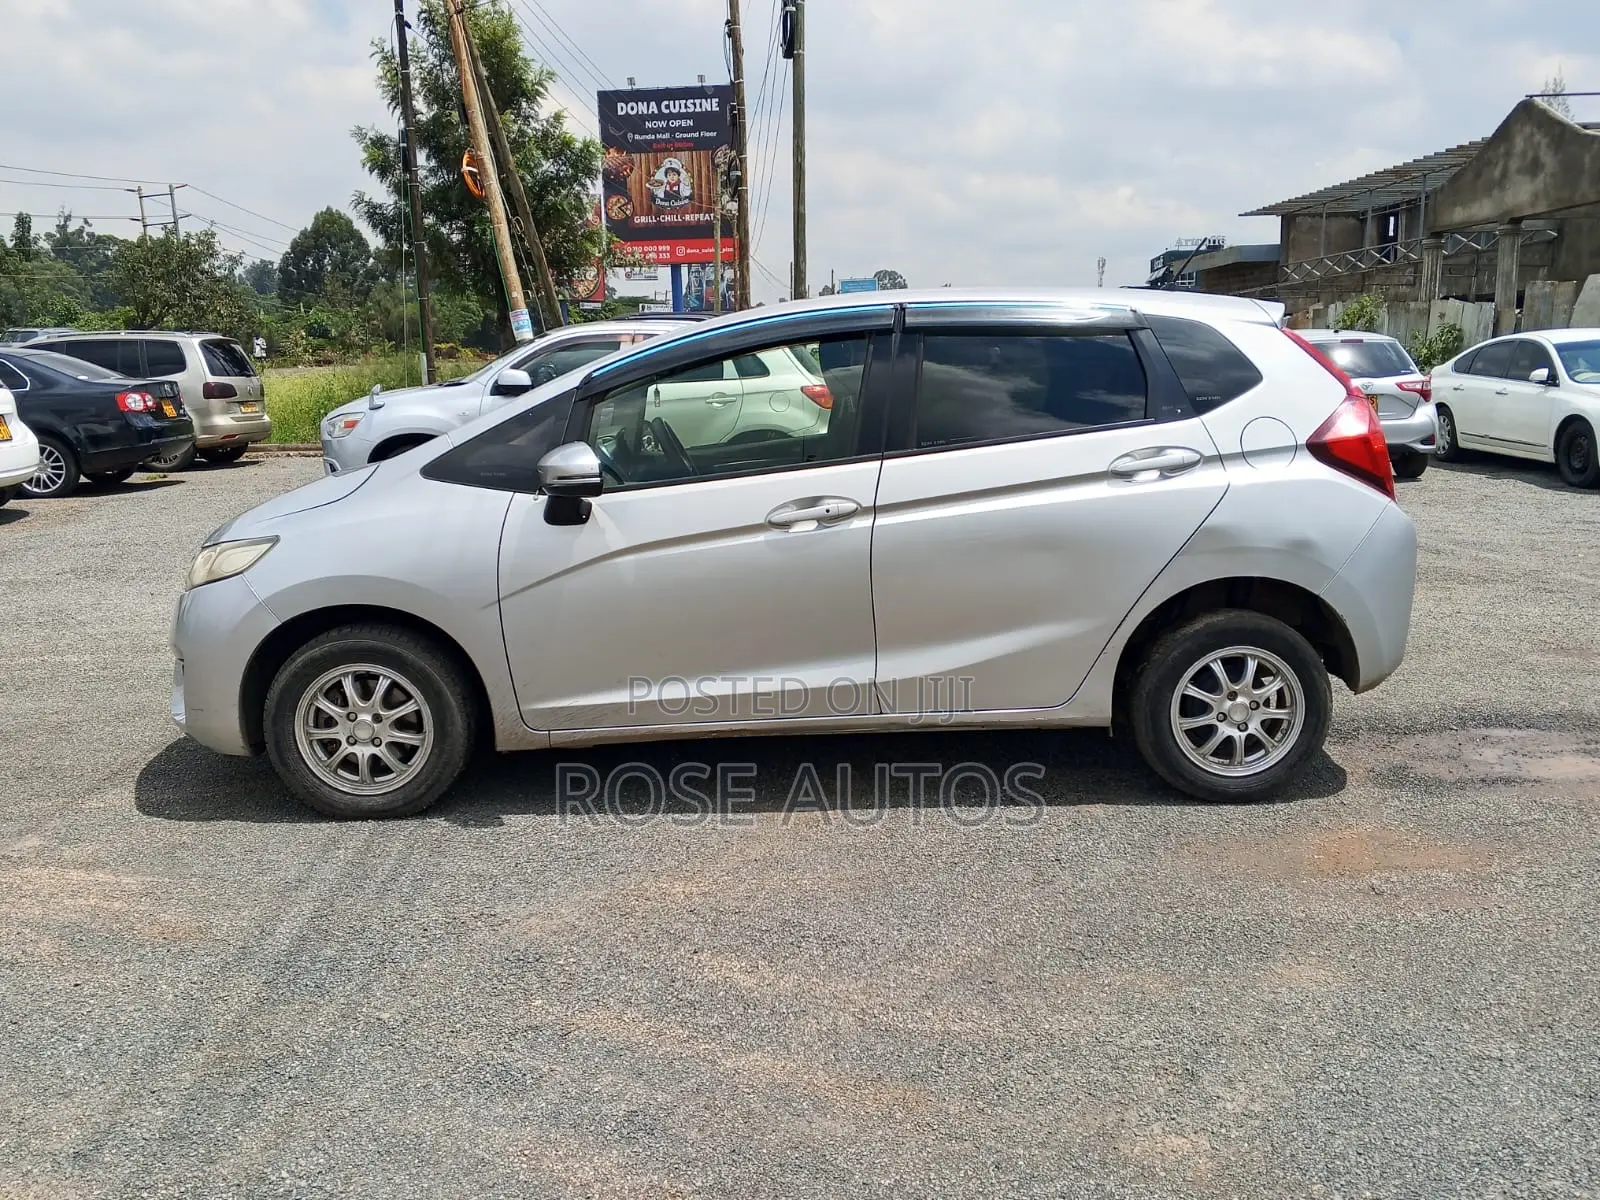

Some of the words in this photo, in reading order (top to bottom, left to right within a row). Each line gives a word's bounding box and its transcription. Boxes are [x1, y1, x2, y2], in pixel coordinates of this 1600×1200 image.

[617, 101, 659, 116] DONA
[661, 98, 720, 114] CUISINE
[645, 120, 668, 129] NOW
[669, 119, 694, 128] OPEN
